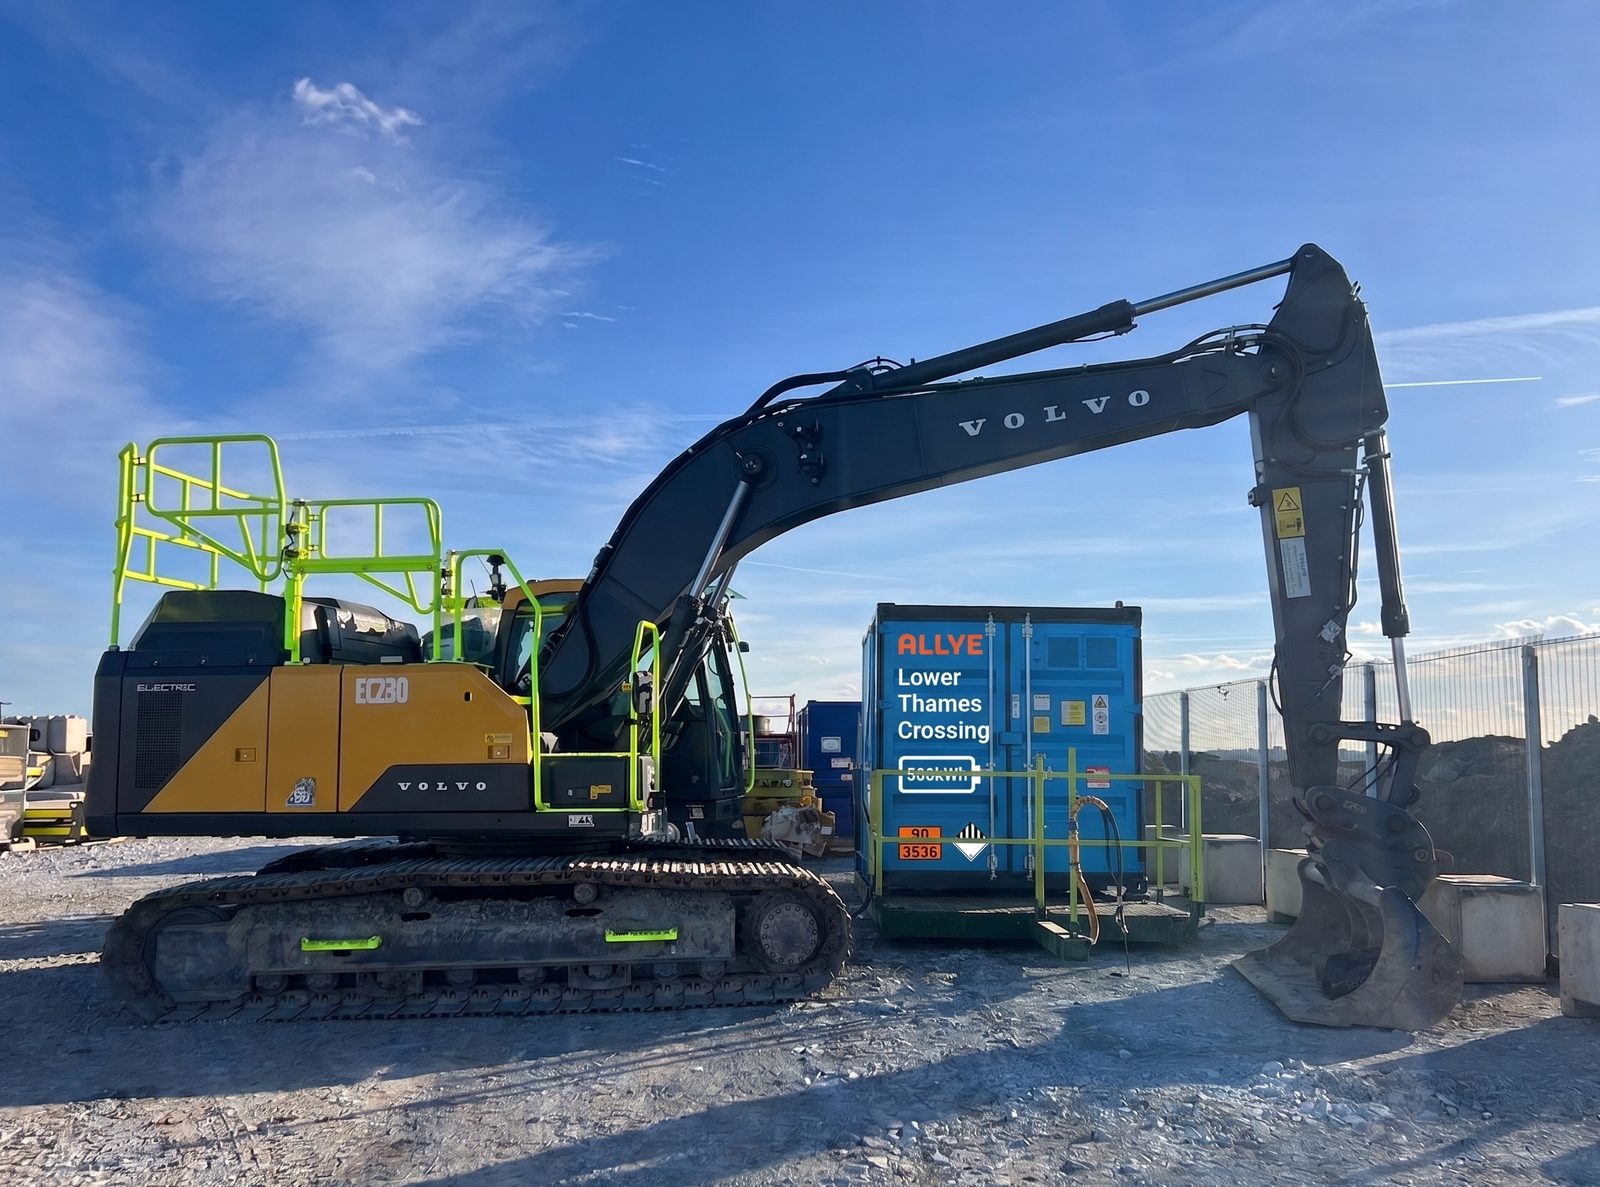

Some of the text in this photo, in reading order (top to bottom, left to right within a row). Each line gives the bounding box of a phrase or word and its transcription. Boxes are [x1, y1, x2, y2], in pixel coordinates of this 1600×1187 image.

[959, 389, 1150, 437] VOLVO
[897, 633, 984, 656] ALLYE
[898, 668, 962, 686] Lower
[136, 683, 196, 692] ELECTRIC
[355, 676, 409, 704] EC230
[898, 693, 982, 713] Thames
[898, 720, 990, 744] Crossing
[397, 782, 487, 791] VOLVO
[911, 828, 929, 838] 90
[903, 846, 938, 858] 3536
